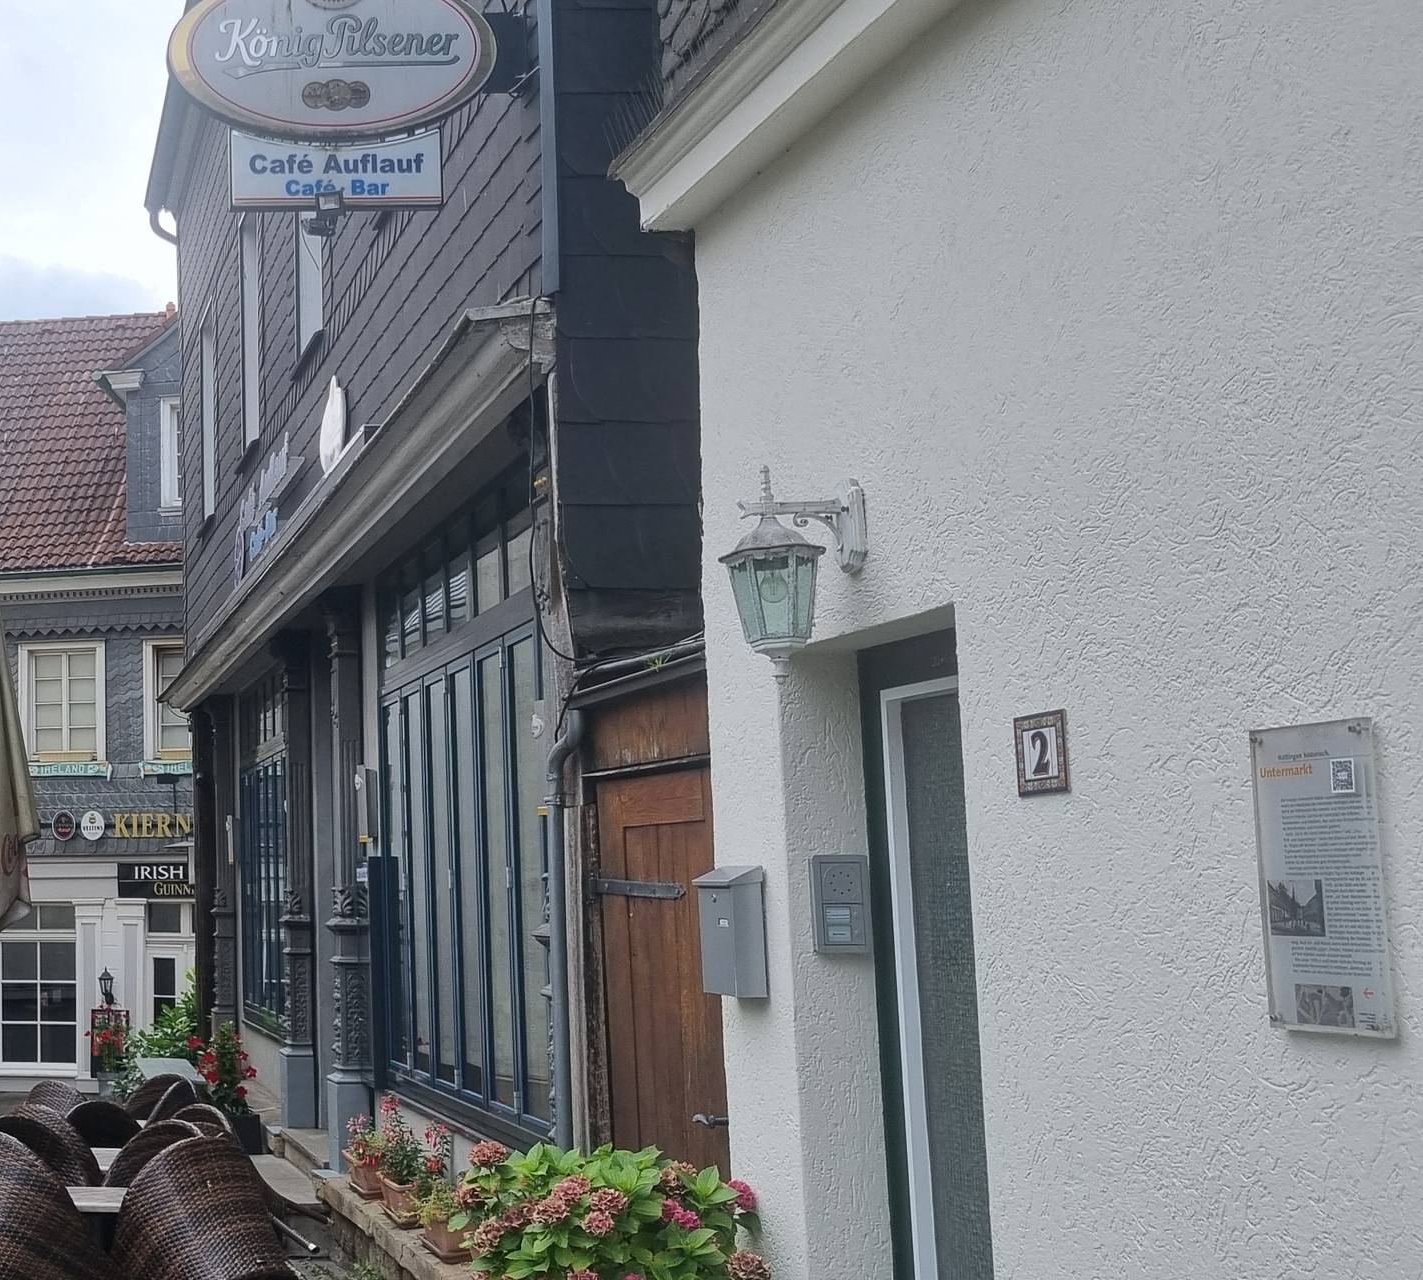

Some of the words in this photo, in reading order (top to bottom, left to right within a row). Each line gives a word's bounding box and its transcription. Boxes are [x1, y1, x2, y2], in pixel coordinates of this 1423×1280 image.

[215, 18, 324, 68] König
[322, 14, 460, 59] Pilsener
[248, 152, 314, 175] Café
[322, 152, 425, 175] Auflauf
[285, 179, 337, 196] Café
[351, 179, 390, 196] Bar
[1030, 731, 1051, 777] 2
[40, 763, 85, 775] IRELAND
[1259, 763, 1314, 778] Untermarkt
[113, 812, 192, 838] KIERN
[134, 865, 184, 880] IRISH
[153, 881, 195, 896] GUINN
